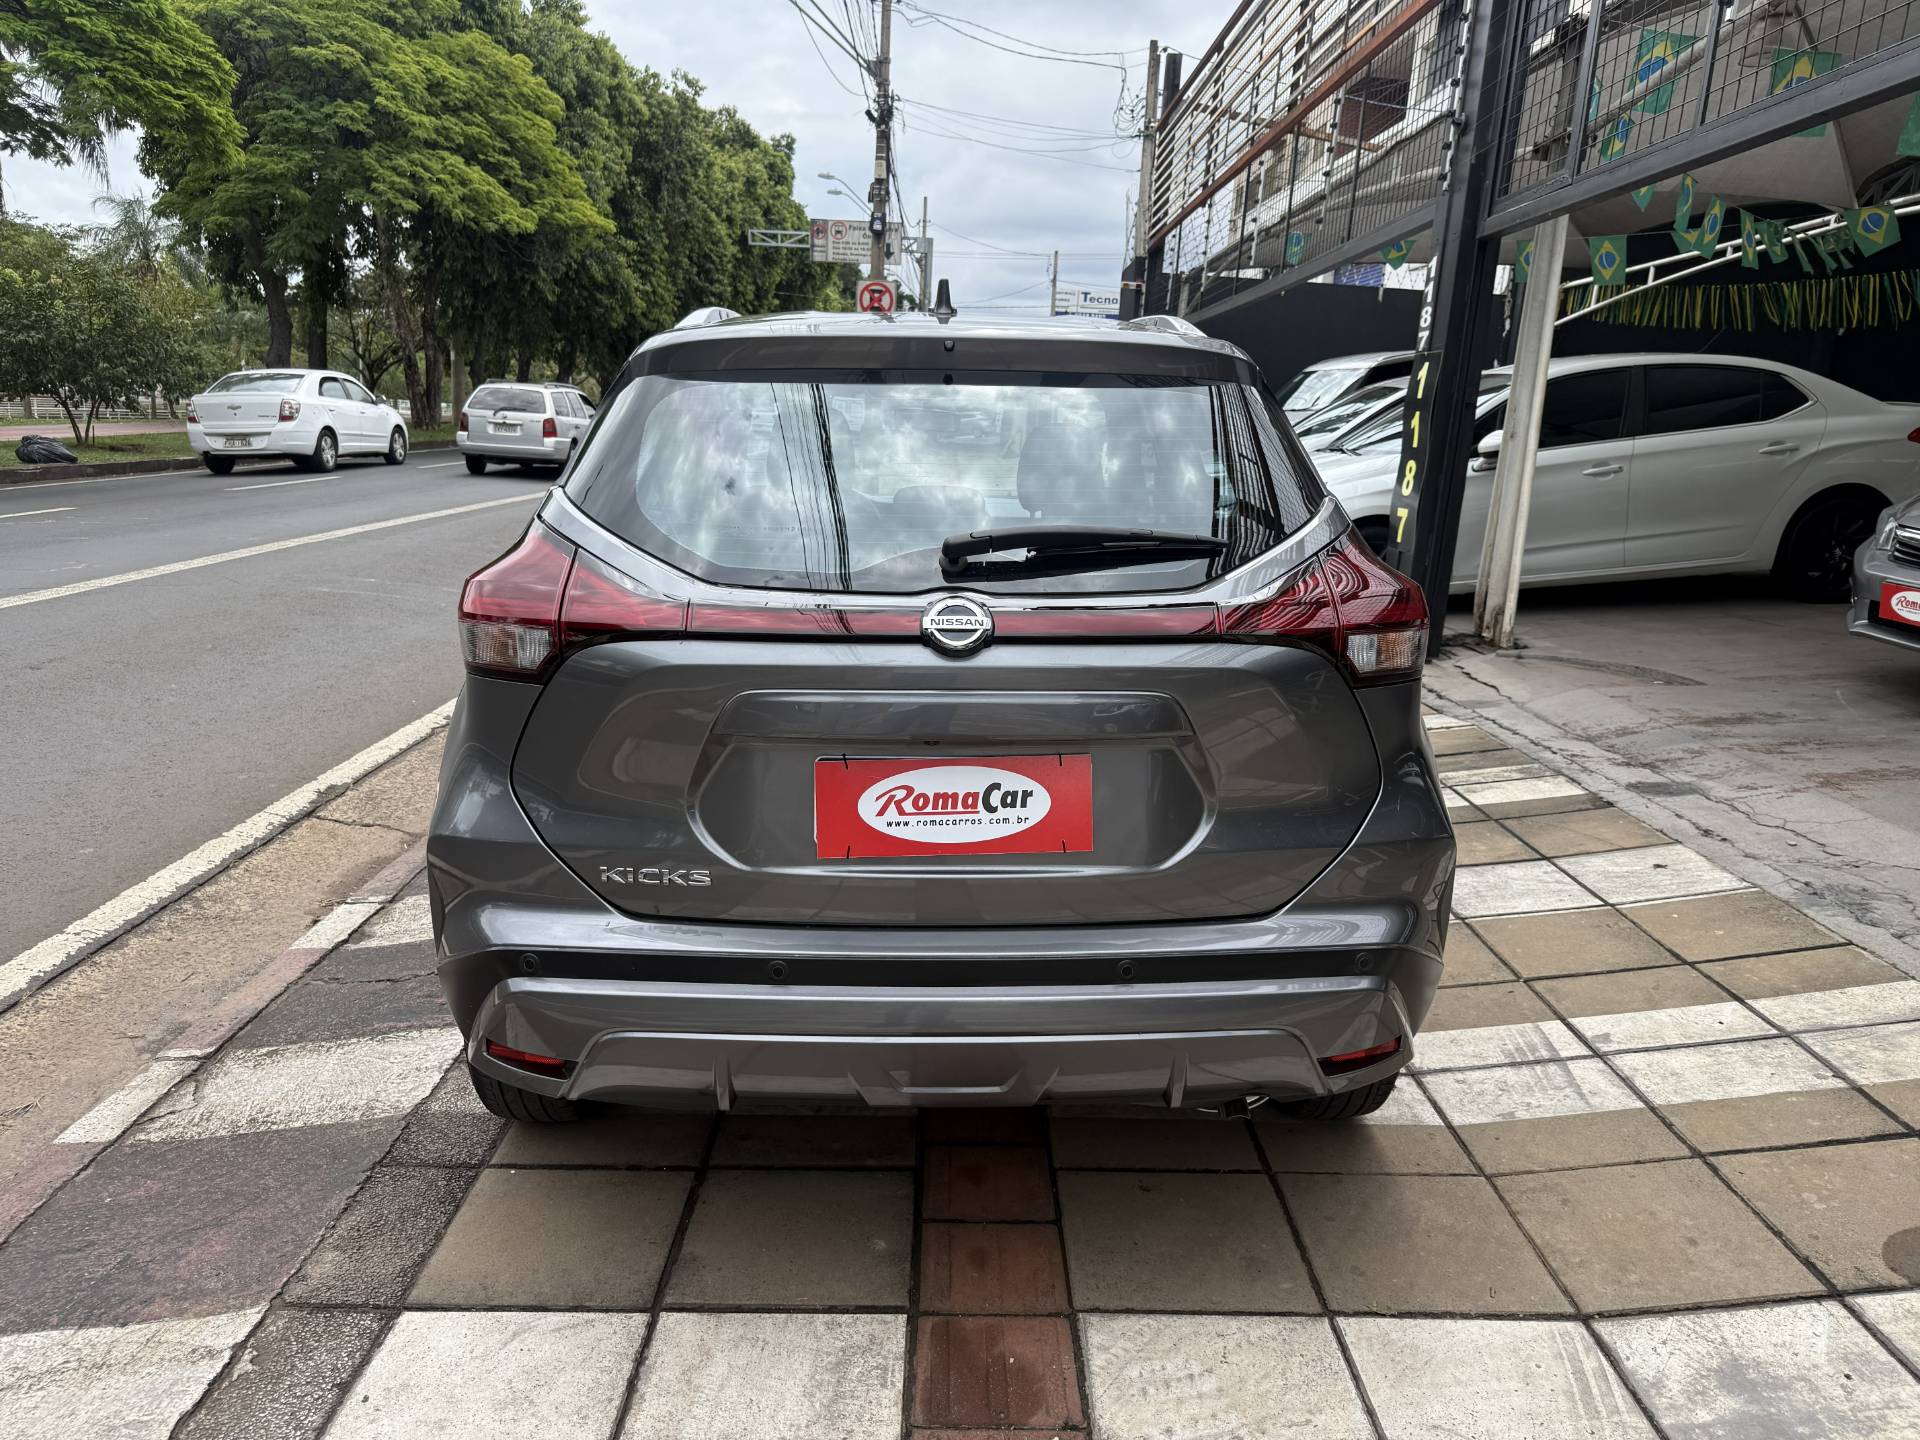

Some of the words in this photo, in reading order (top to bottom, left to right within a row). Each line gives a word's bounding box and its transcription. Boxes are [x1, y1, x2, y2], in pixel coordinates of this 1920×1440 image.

[1081, 292, 1119, 304] Tecno
[1418, 255, 1438, 351] 1187
[1397, 361, 1429, 543] 1187
[930, 618, 984, 627] NISSAN
[875, 782, 1034, 817] RomaCar
[886, 815, 1030, 828] www.romacarros.com.br
[599, 866, 712, 886] KICKS
